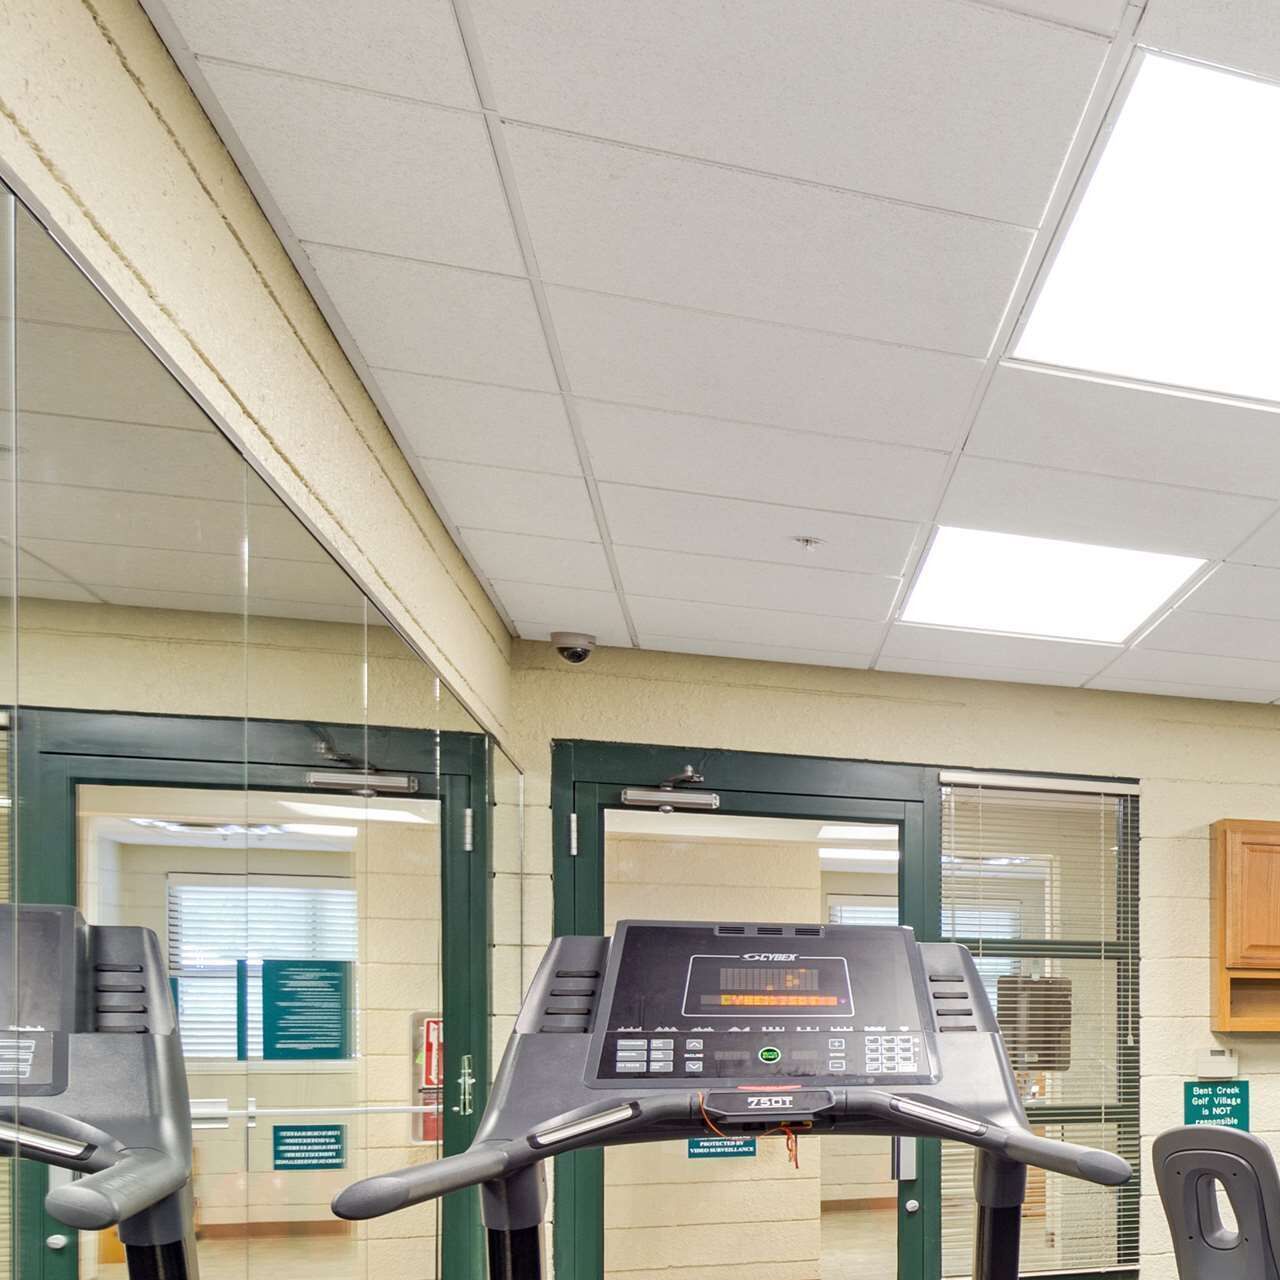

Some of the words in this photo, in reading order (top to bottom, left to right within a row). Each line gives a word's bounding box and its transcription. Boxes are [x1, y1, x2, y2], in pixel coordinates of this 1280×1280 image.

[760, 953, 799, 961] CYBEX
[1193, 1086, 1213, 1095] Bent
[1216, 1086, 1240, 1094] Creek
[747, 1096, 793, 1108] 750T
[1191, 1097, 1209, 1105] Golf
[1213, 1097, 1241, 1105] Village
[1202, 1107, 1209, 1115] is
[1212, 1107, 1232, 1115] NOT
